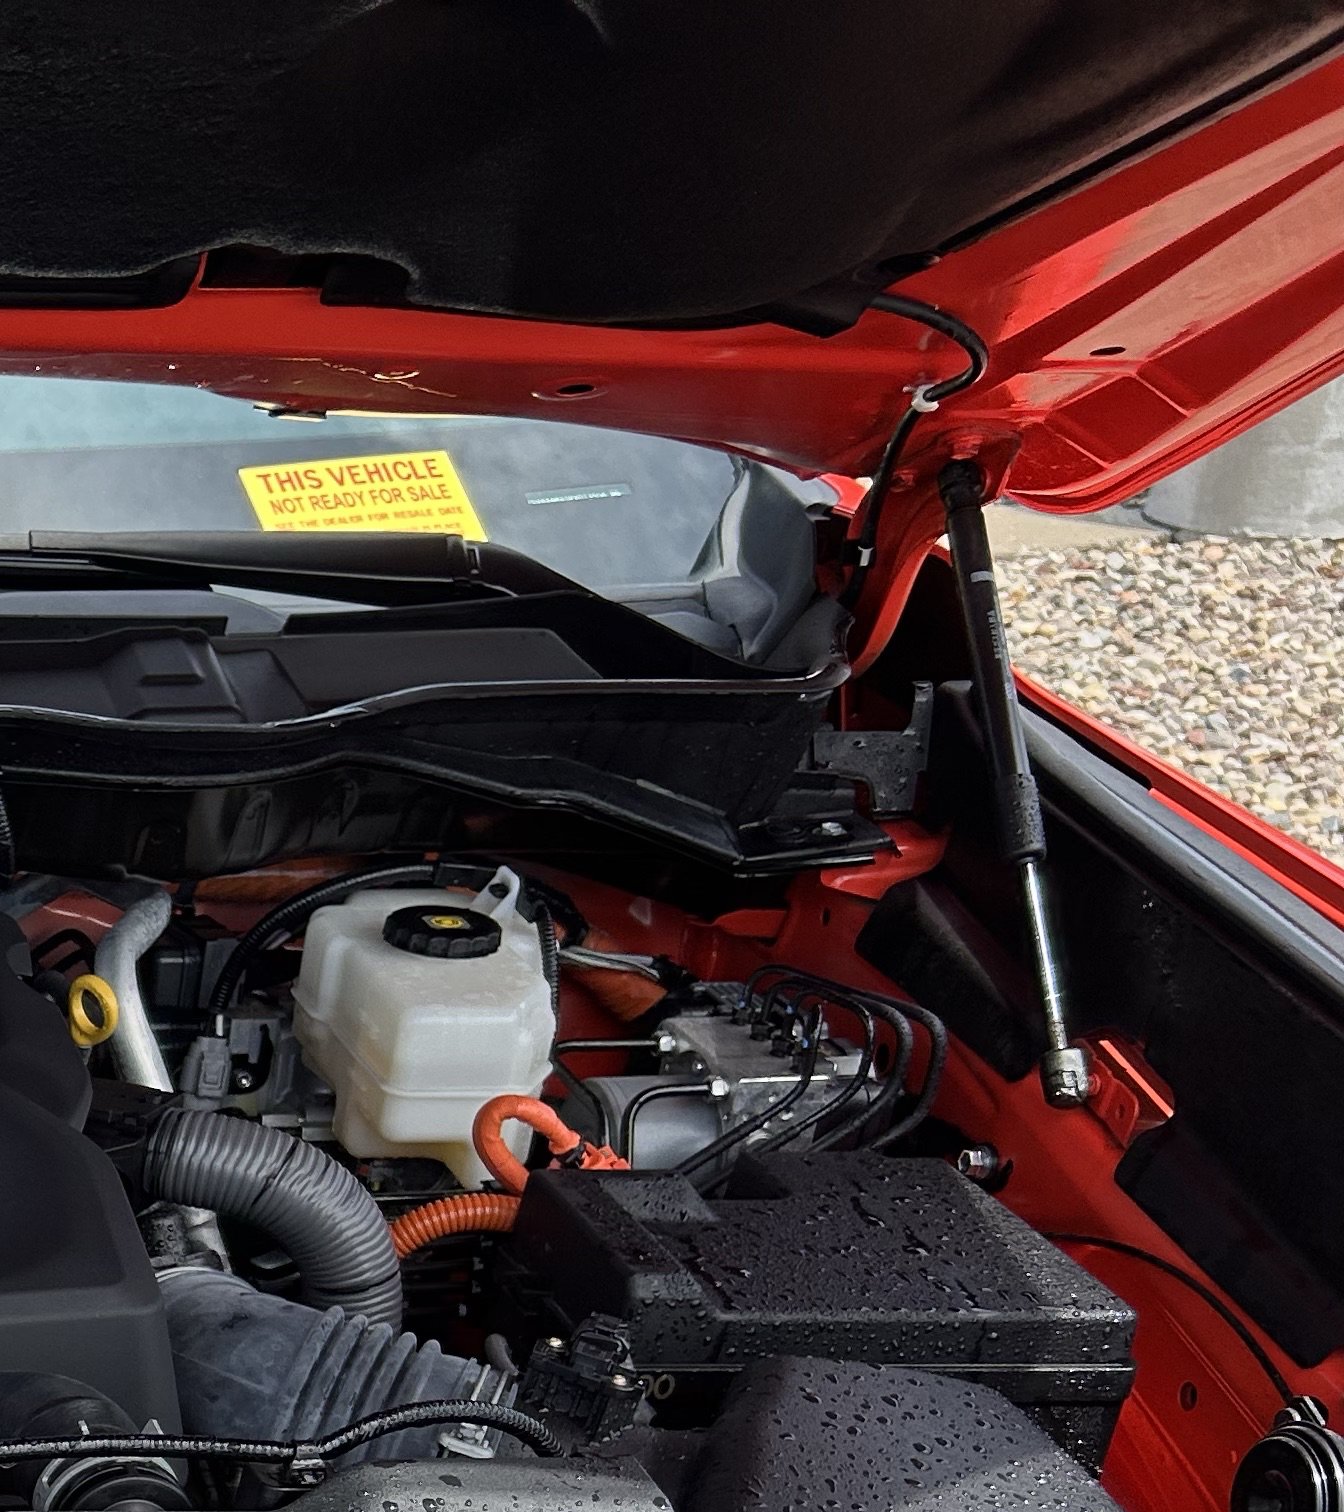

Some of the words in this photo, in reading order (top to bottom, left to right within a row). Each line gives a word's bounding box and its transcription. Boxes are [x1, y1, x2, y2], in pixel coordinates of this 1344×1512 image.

[256, 469, 324, 494] THIS
[326, 459, 443, 486] VEHICLE
[269, 497, 306, 515] NOT
[309, 491, 366, 511] READY
[369, 487, 406, 505] FOR
[407, 483, 452, 502] SALE
[274, 521, 296, 530] SEE
[299, 519, 319, 528] THE
[322, 514, 364, 525] DEALER
[367, 512, 389, 521] FOR
[393, 508, 434, 519] RESALE
[438, 506, 464, 516] DATE
